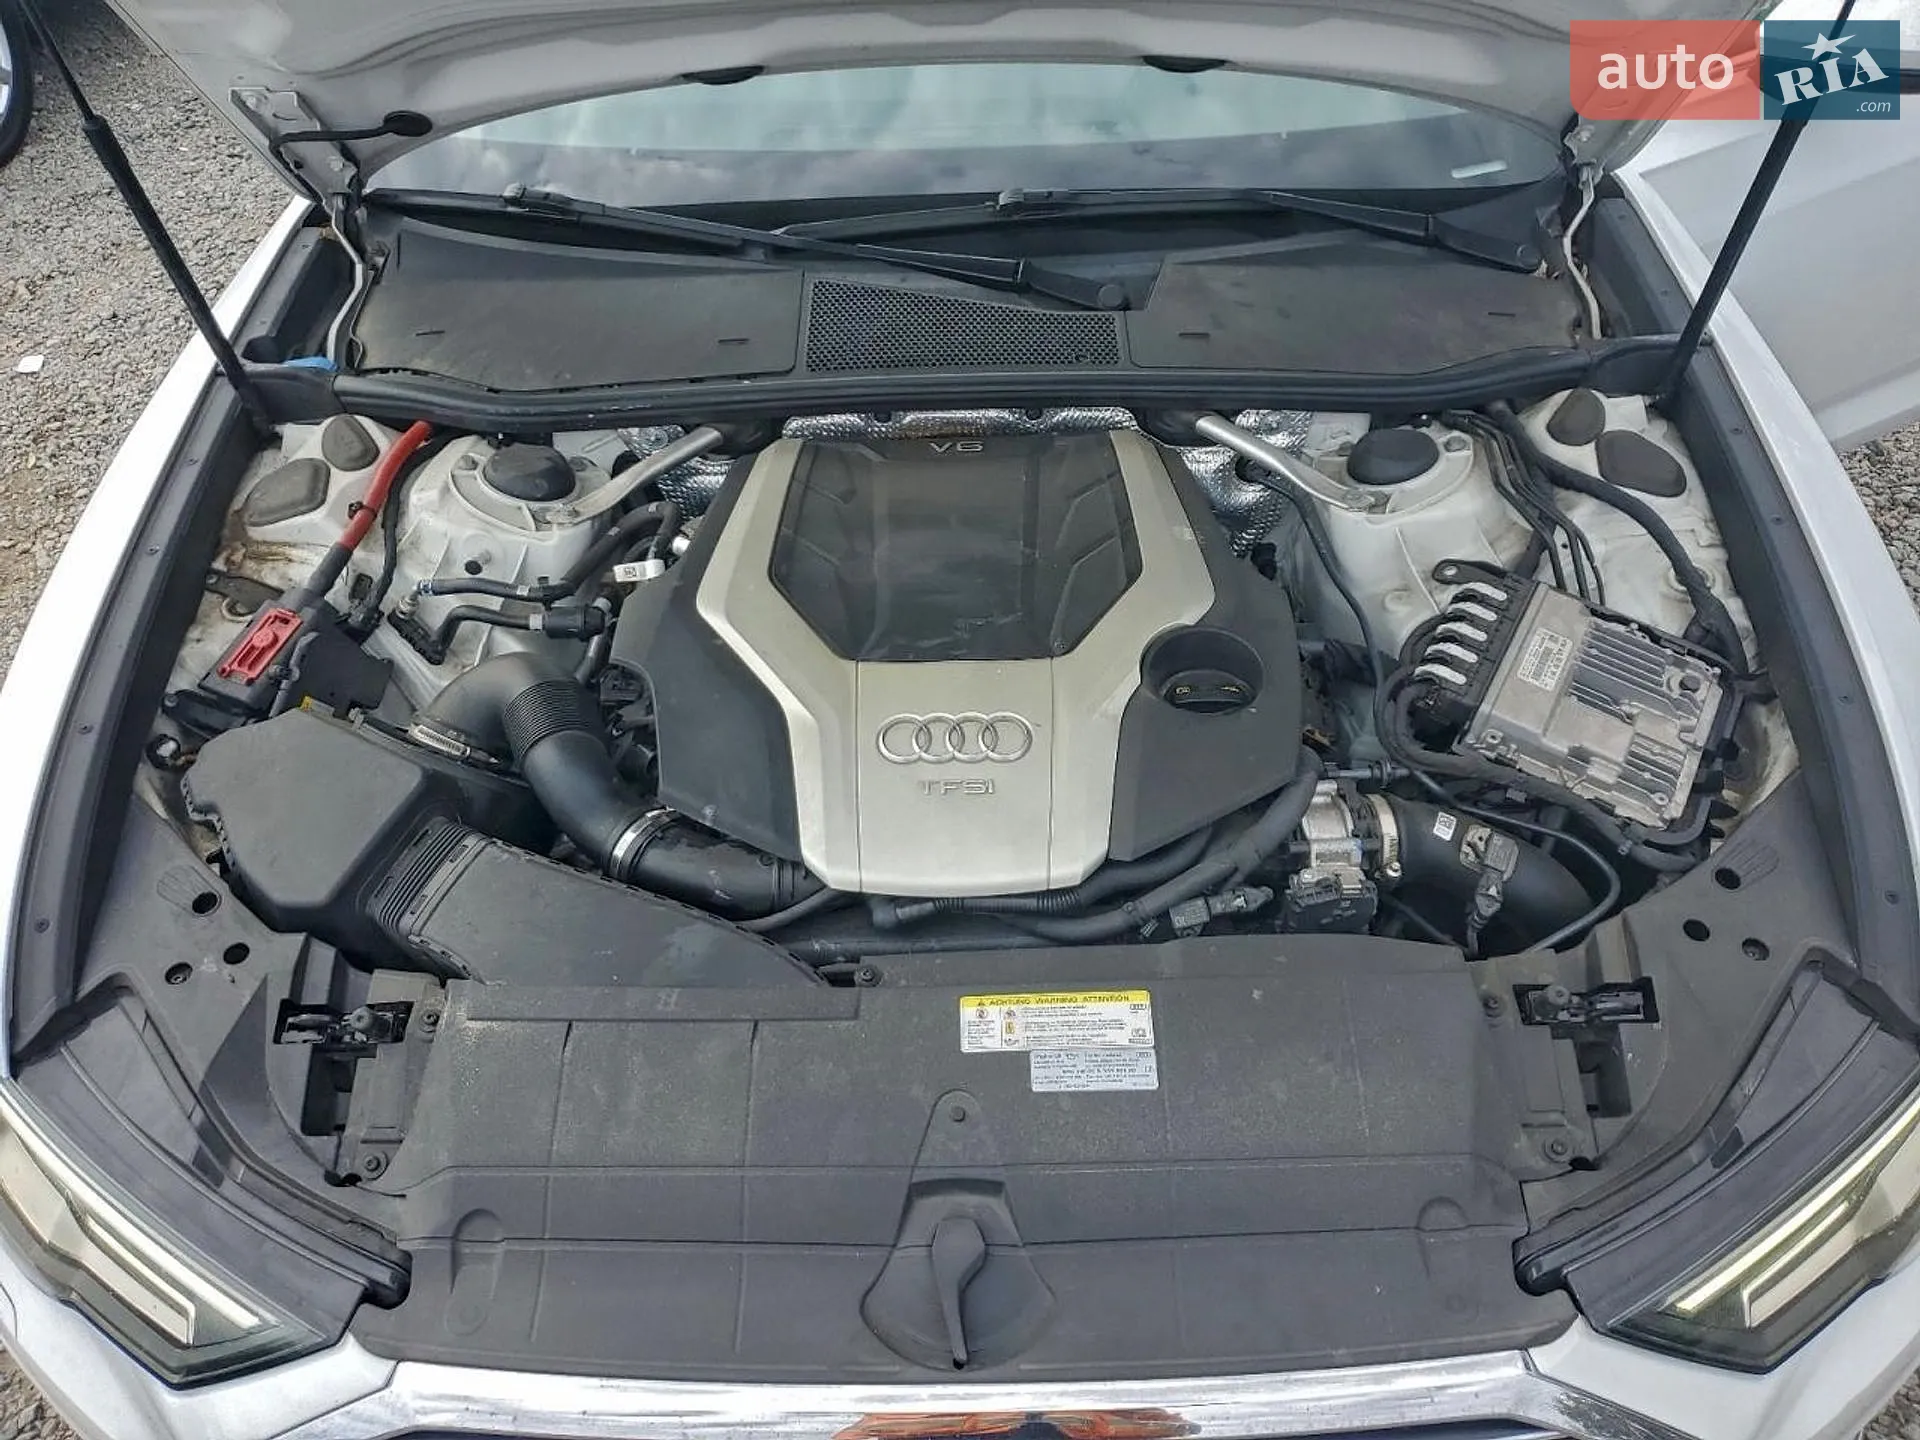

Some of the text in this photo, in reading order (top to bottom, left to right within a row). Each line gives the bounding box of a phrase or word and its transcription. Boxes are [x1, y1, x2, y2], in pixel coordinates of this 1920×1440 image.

[928, 440, 984, 453] V6
[919, 778, 995, 795] TFSI
[1082, 994, 1129, 1003] ATTENTION
